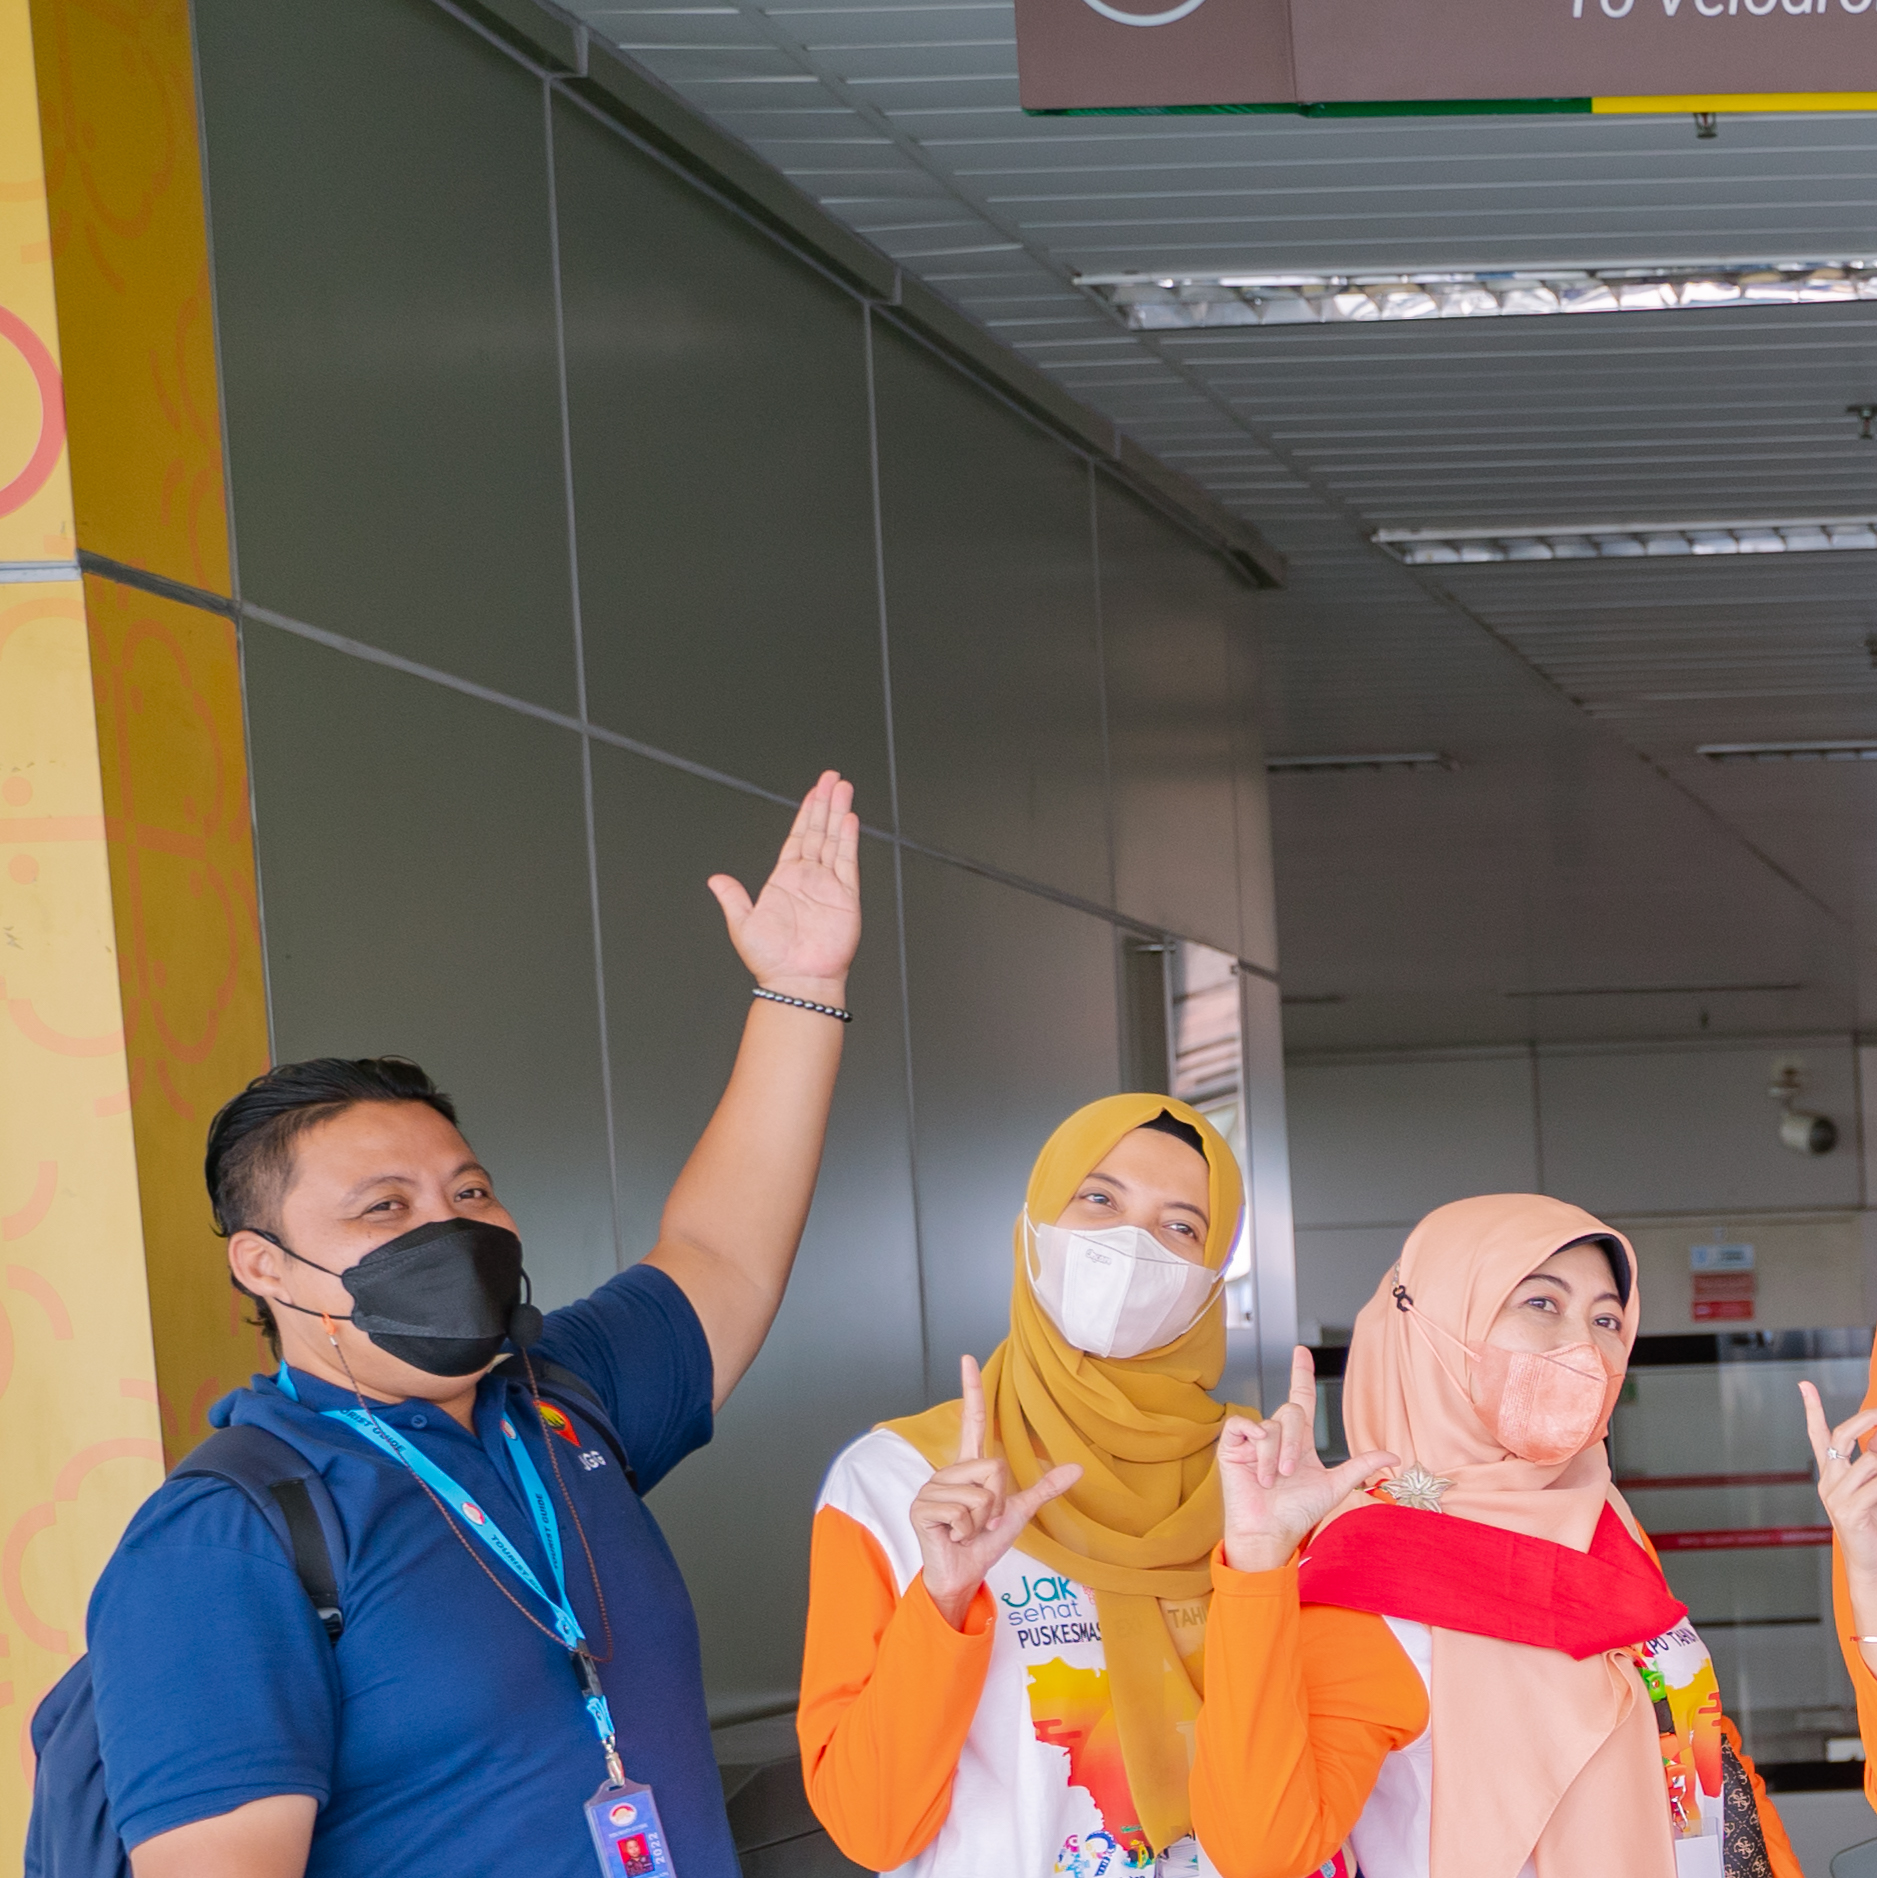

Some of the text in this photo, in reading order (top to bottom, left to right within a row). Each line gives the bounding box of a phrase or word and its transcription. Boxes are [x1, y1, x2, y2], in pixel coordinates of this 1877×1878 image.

[339, 1407, 371, 1434] URIST
[535, 1493, 559, 1570] TOURIST GUIDE
[491, 1534, 529, 1581] TOURIST
[1001, 1575, 1078, 1608] Jak
[1008, 1600, 1082, 1627] sehat
[1167, 1605, 1208, 1629] TAH
[649, 1832, 665, 1865] 2022
